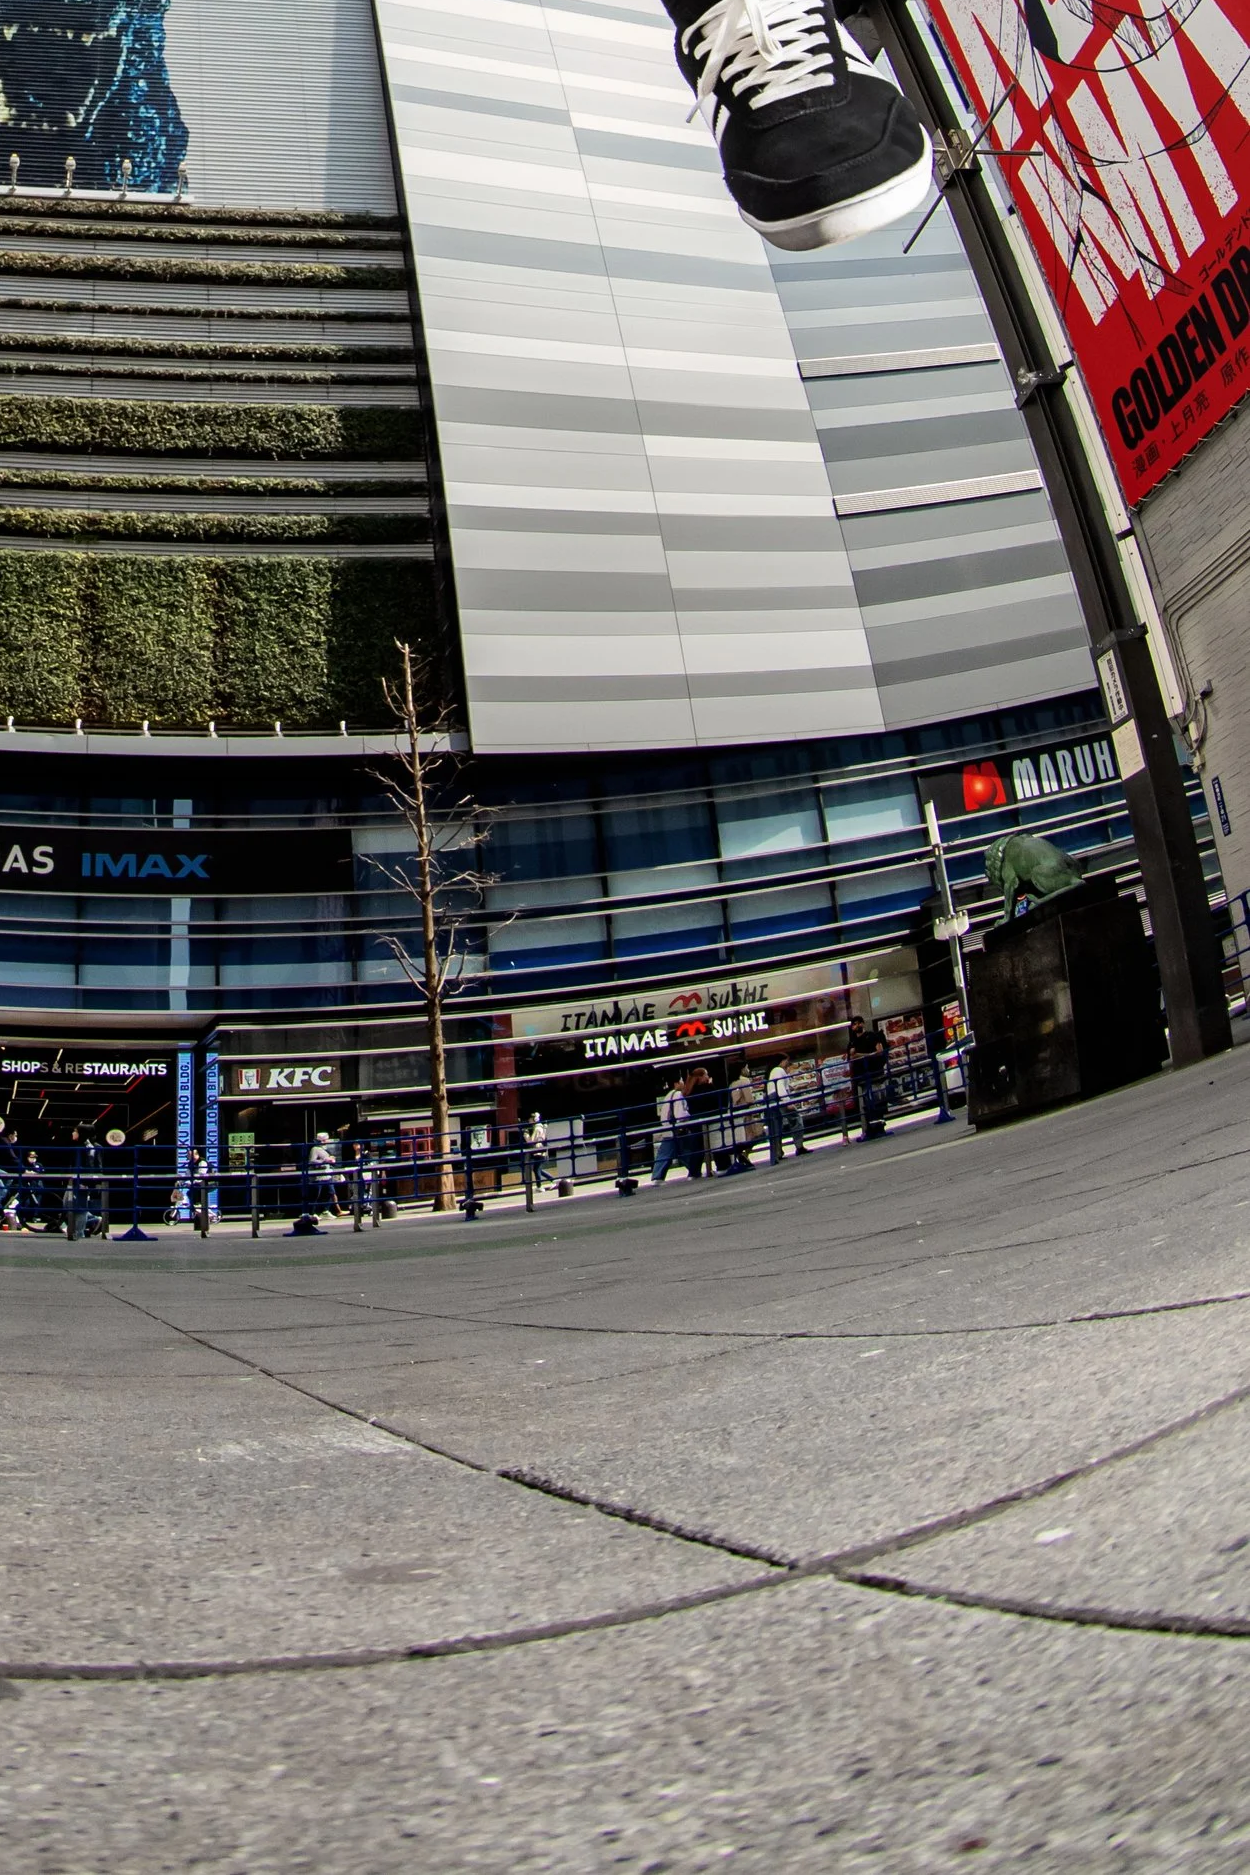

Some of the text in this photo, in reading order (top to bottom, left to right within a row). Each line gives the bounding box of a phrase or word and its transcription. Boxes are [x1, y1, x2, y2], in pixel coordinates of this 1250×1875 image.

[1111, 292, 1228, 451] GOLDEN
[1012, 739, 1115, 801] MARUH
[81, 852, 211, 879] IMAX
[560, 983, 769, 1032] ITAMAE SUSHI
[582, 1011, 769, 1059] ITAMAE SUSHI
[1, 1060, 167, 1075] SHOPS & RESTAURANTS
[177, 1061, 191, 1092] BLDG.
[265, 1065, 333, 1089] KFC
[177, 1094, 190, 1127] TOHO
